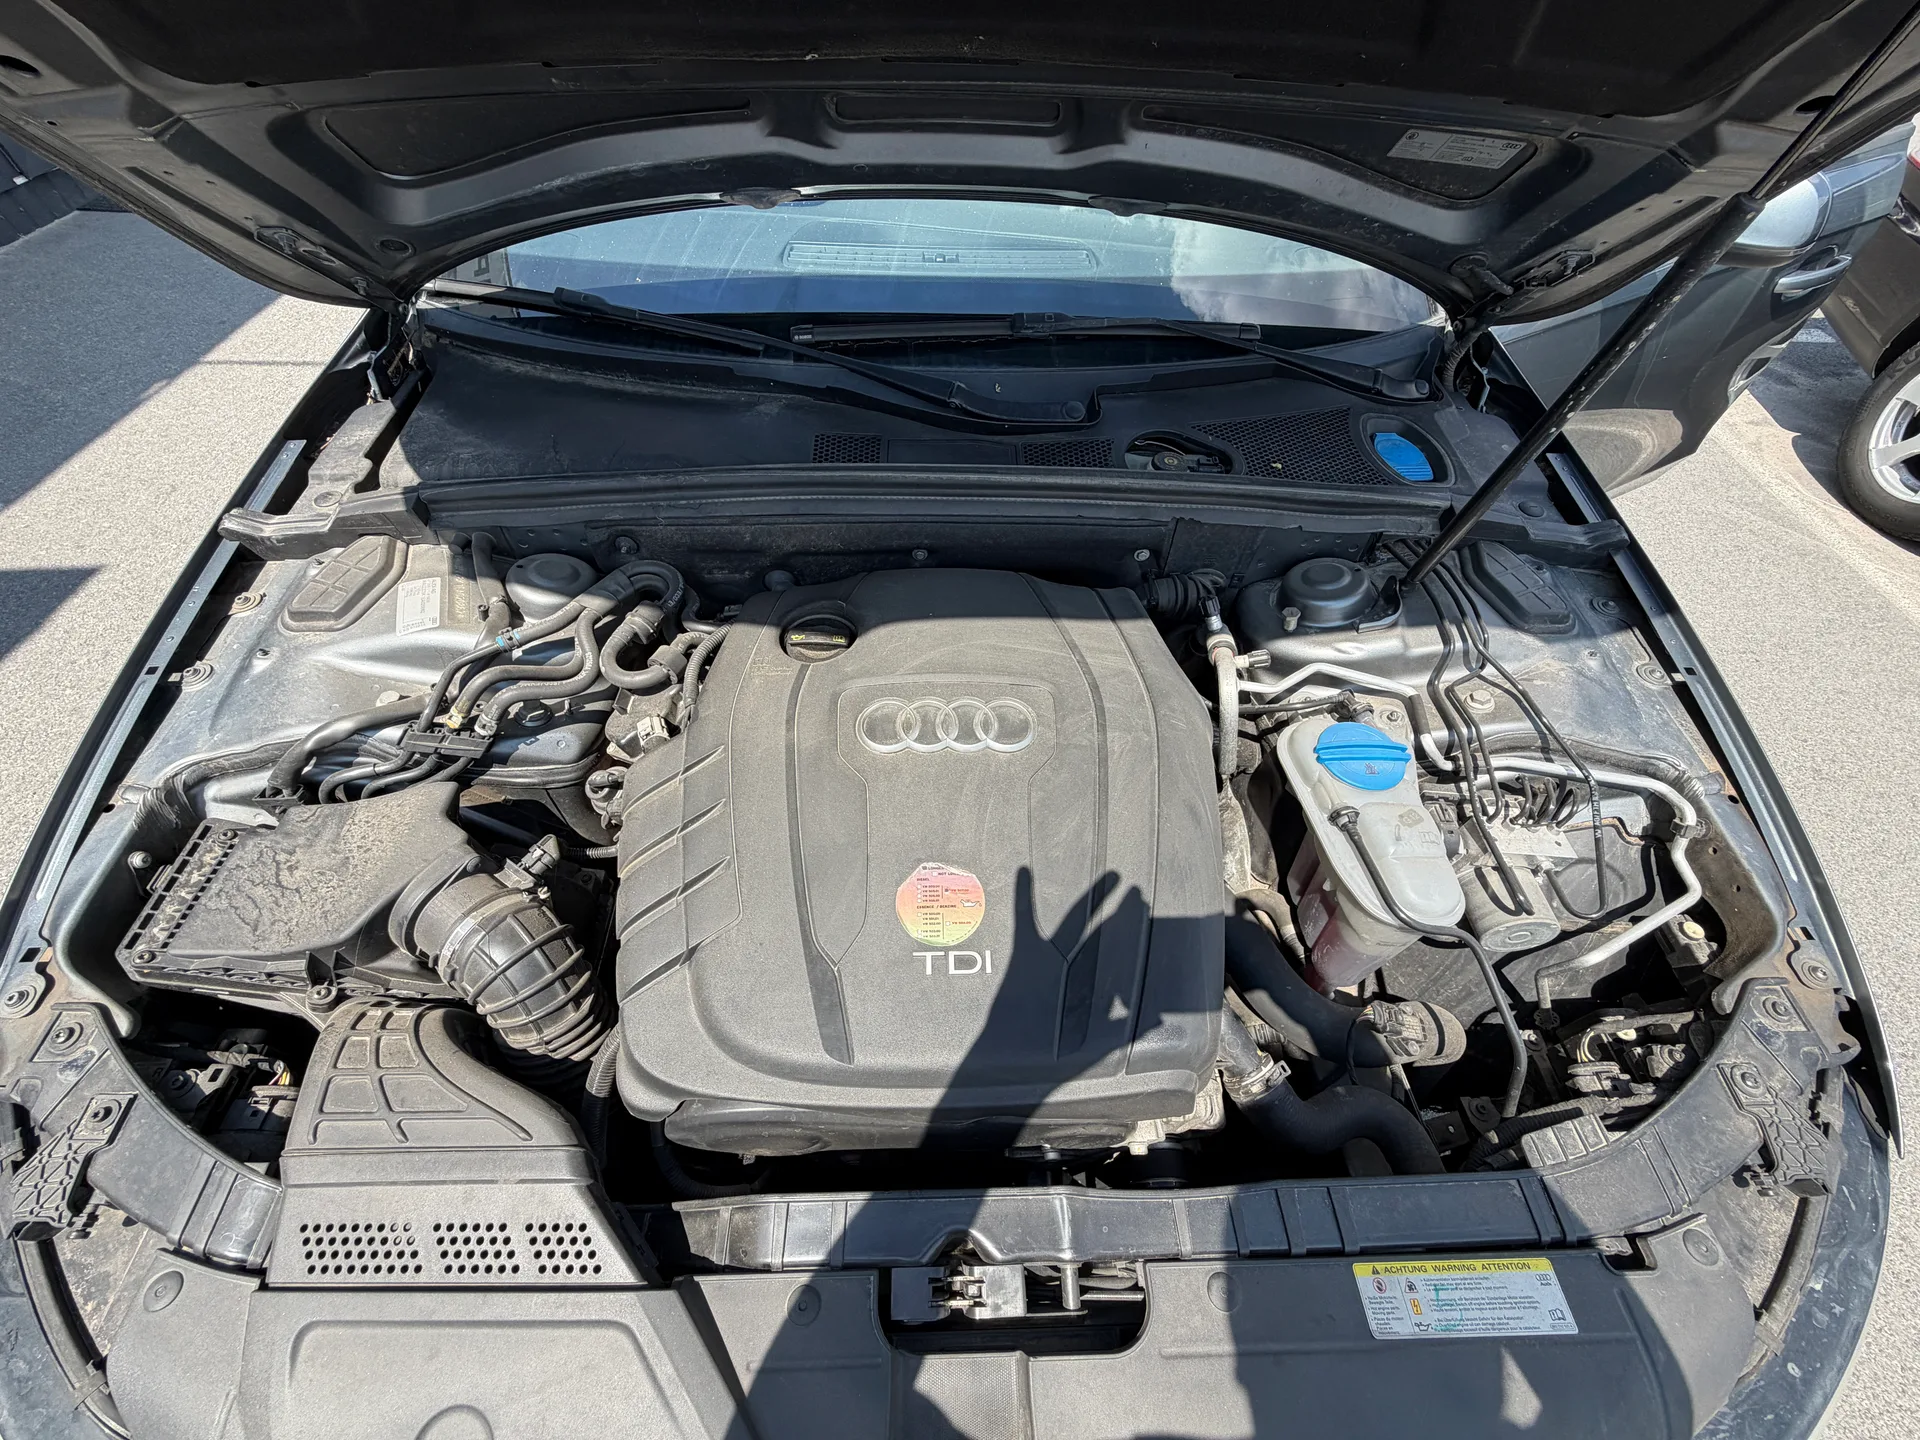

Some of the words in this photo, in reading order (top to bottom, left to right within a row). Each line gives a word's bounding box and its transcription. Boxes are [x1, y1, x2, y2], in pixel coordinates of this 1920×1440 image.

[912, 949, 992, 976] TDI
[1384, 1265, 1428, 1274] ACHTUNG
[1431, 1263, 1477, 1272] WARNING
[1481, 1262, 1531, 1271] ATTENTION
